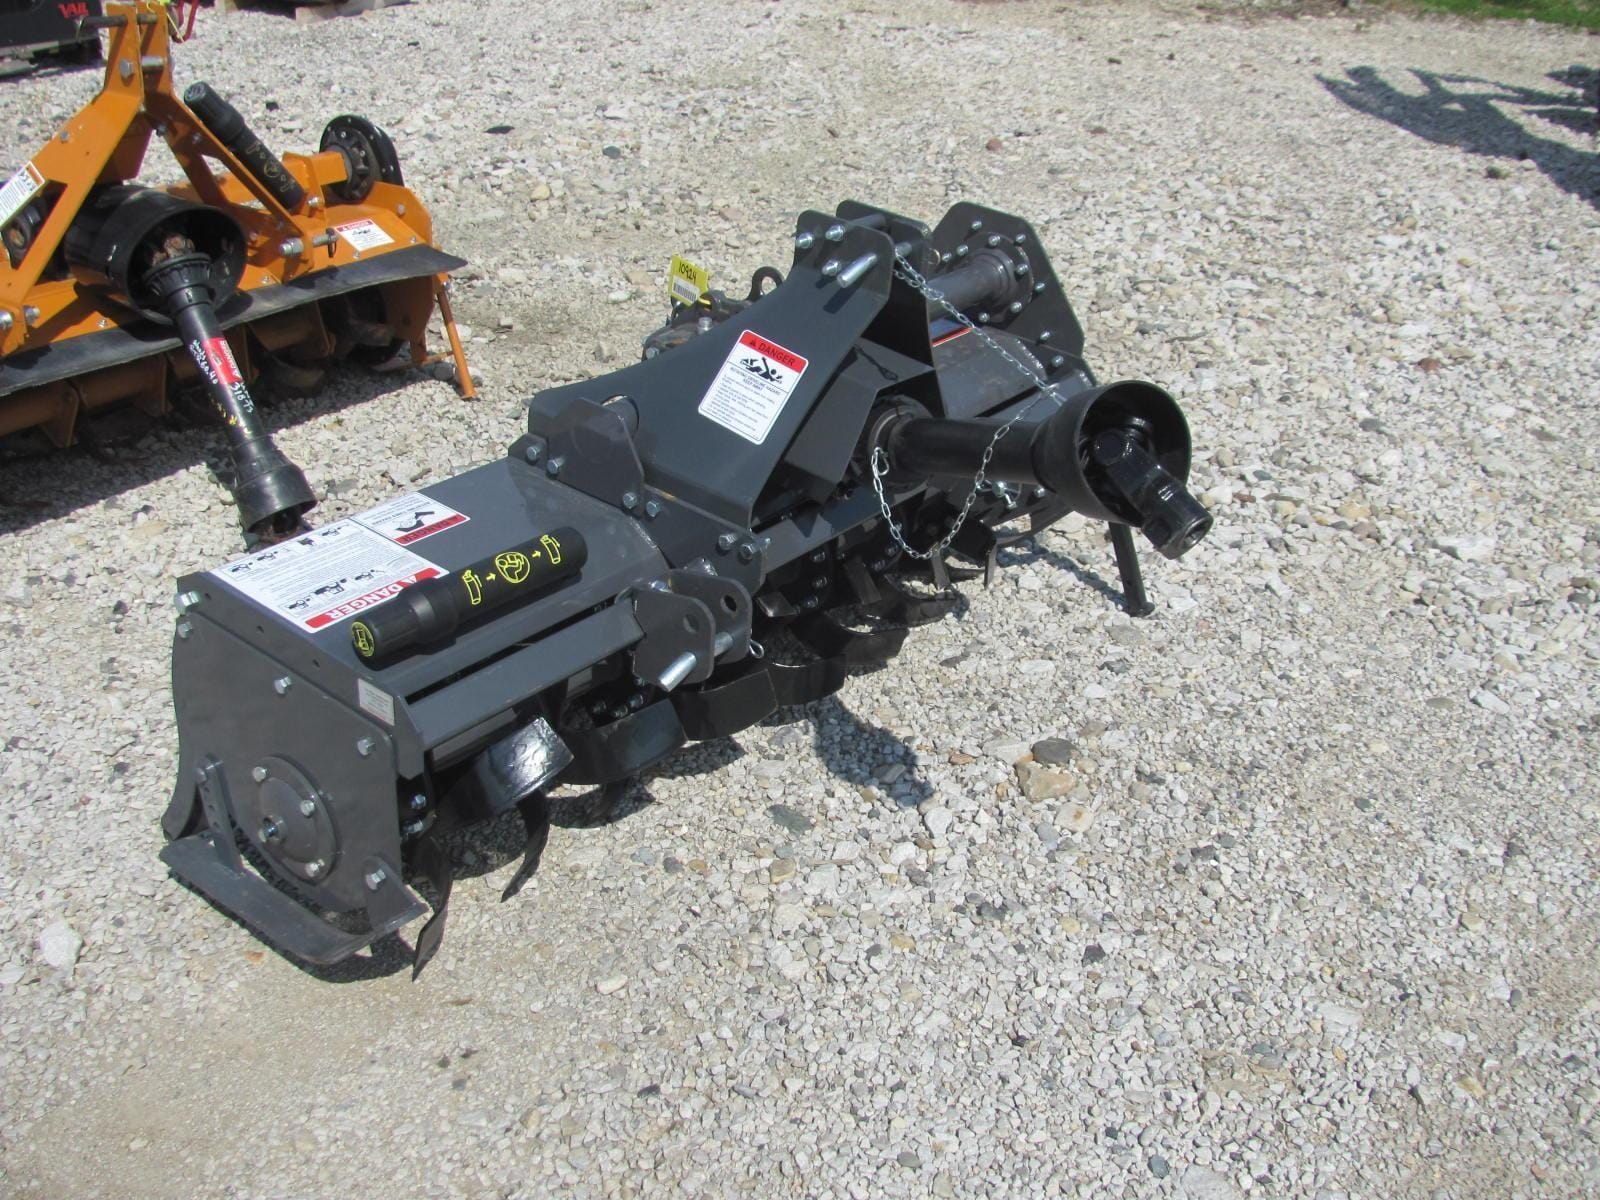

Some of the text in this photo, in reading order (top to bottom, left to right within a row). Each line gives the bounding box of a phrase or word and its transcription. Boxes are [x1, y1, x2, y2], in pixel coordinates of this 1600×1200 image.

[678, 261, 697, 286] 10924
[758, 341, 796, 367] DANGER
[325, 583, 405, 619] DANGER
